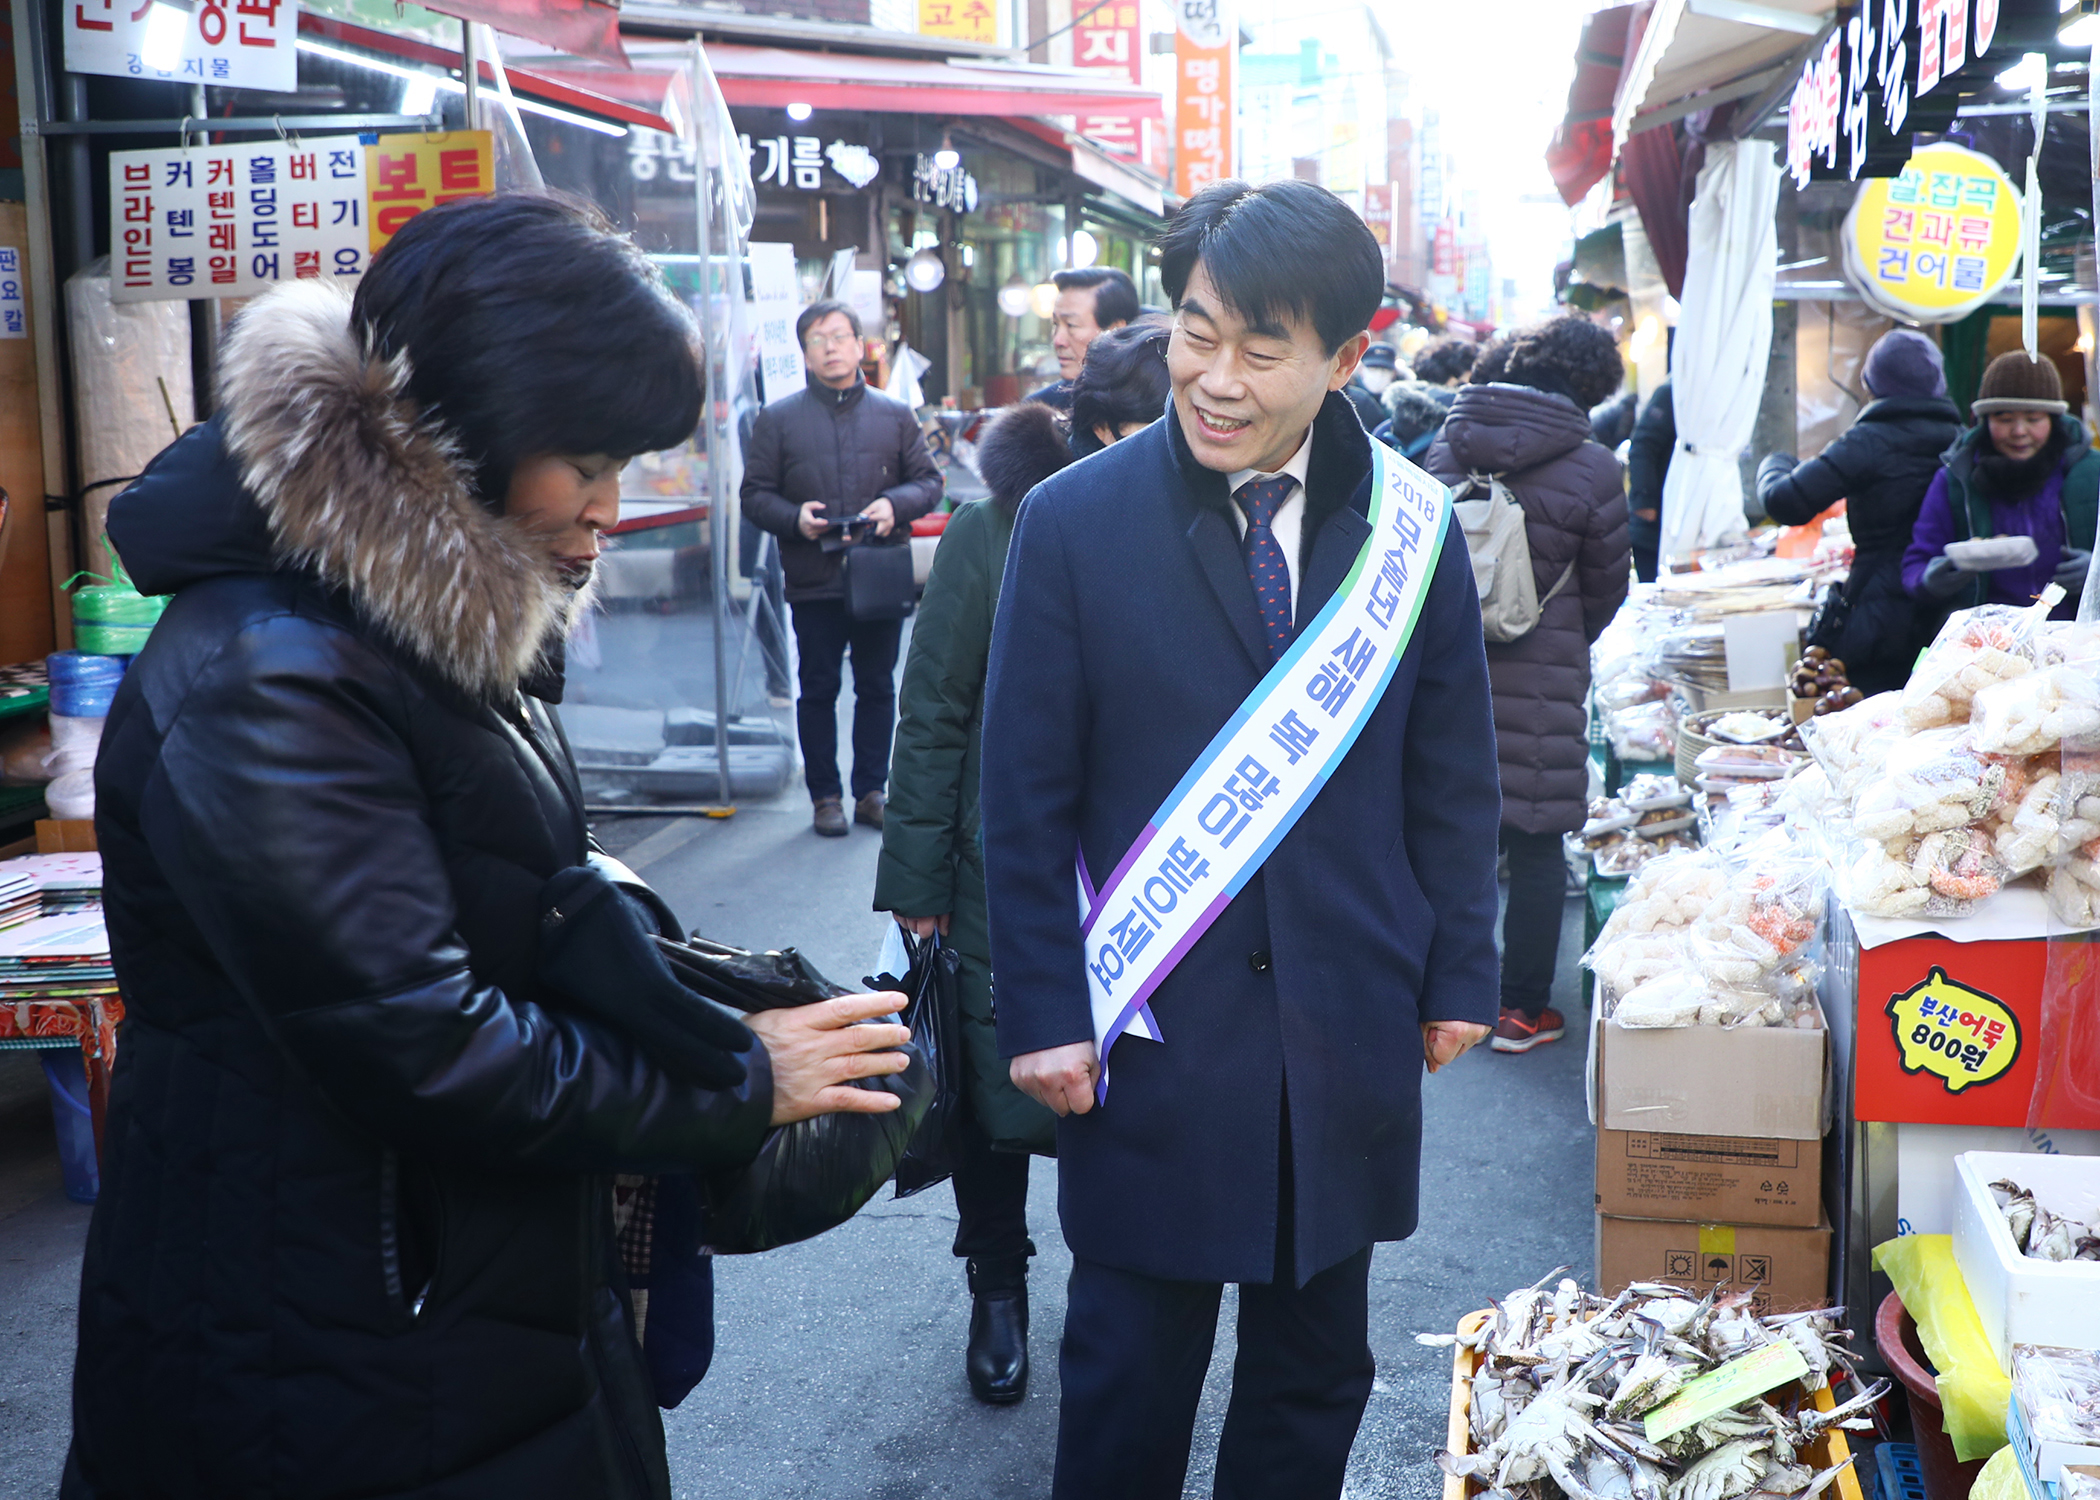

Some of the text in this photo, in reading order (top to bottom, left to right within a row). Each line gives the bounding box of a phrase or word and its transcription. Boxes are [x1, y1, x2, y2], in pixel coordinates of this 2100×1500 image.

[127, 53, 231, 79] 강지물
[124, 163, 154, 288] 브라인드
[166, 160, 196, 286] 커텐봉
[207, 158, 237, 285] 커텐레일
[249, 156, 280, 281] 홀딩도어
[289, 153, 321, 280] 버티컬
[328, 150, 362, 277] 전기요
[1885, 208, 1990, 251] 견과류
[1879, 247, 1985, 291] 건어물
[1391, 472, 1435, 523] 2018
[1365, 505, 1422, 632] 무술년
[1305, 625, 1379, 720] 새해
[1270, 707, 1321, 767] 복
[1197, 753, 1282, 850] 많이
[1088, 834, 1212, 998] 받으세요
[1911, 1023, 1989, 1073] 800원
[1918, 995, 2007, 1051] 부산어묵
